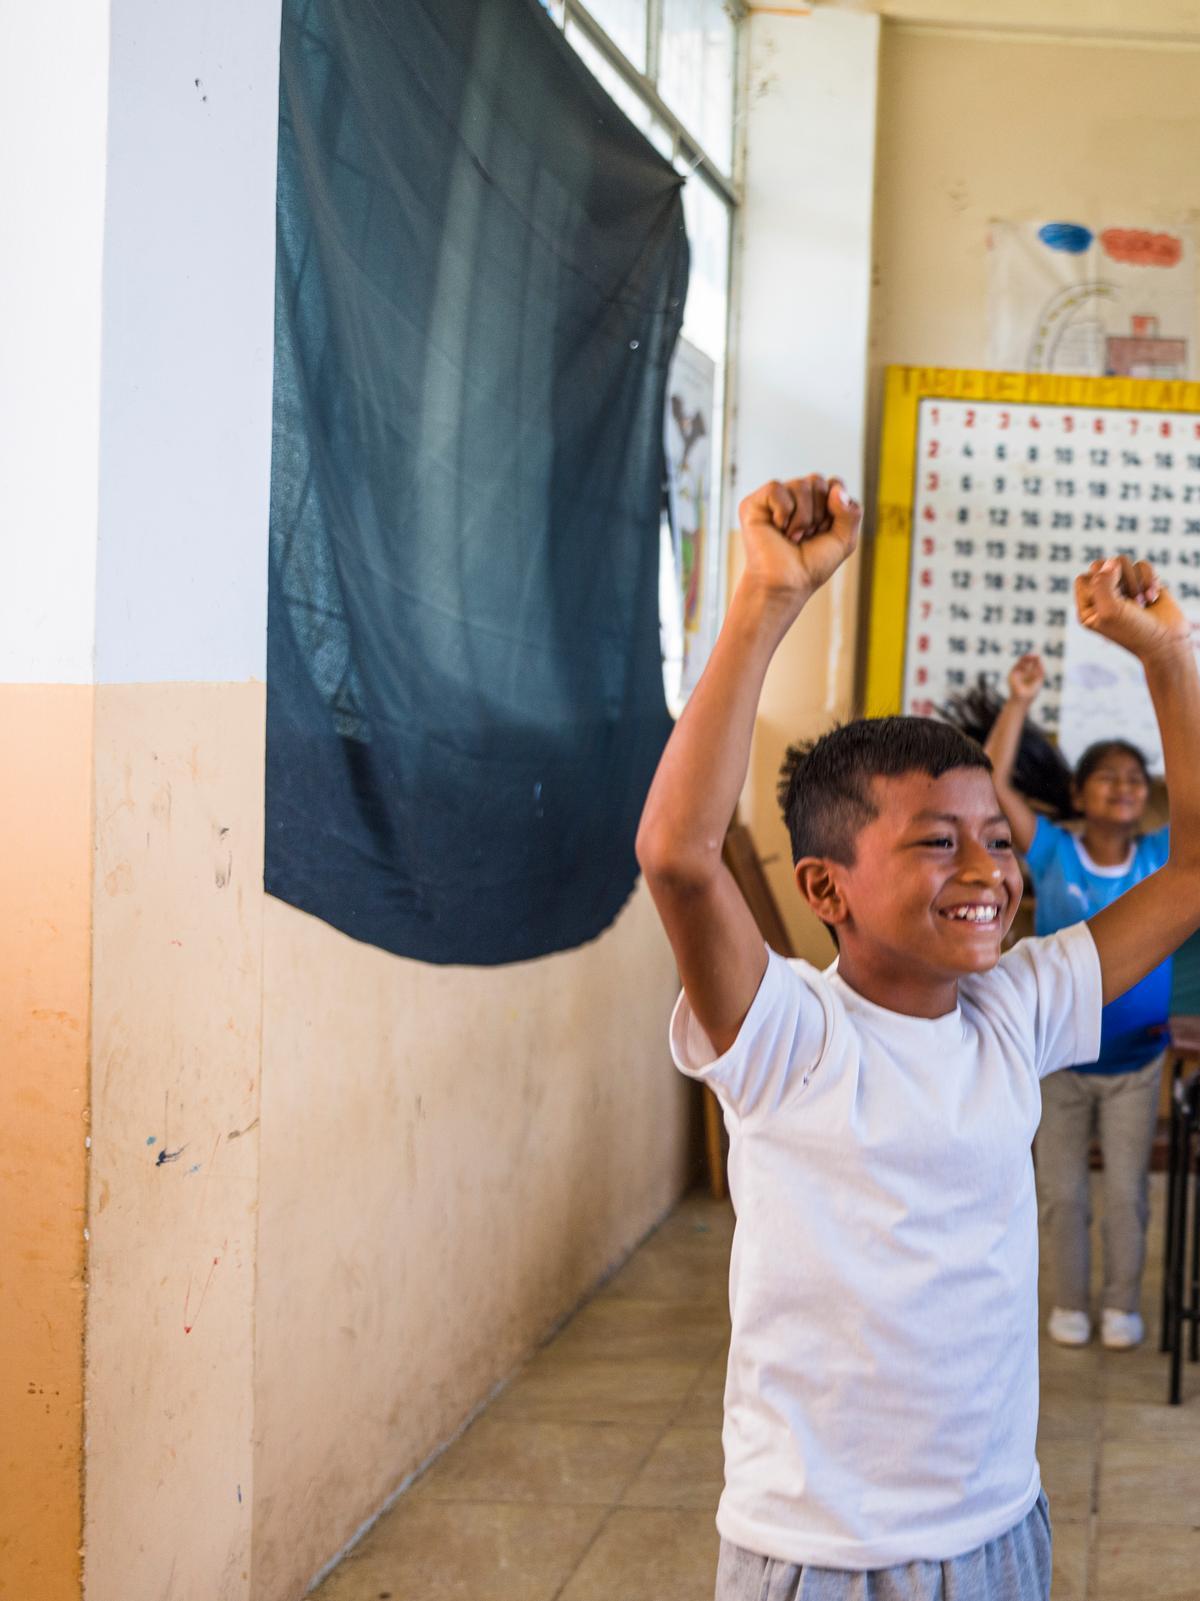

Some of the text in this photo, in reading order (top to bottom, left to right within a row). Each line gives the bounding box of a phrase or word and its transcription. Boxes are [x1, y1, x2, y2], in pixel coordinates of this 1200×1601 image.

[930, 406, 940, 426] 1
[964, 409, 977, 429] 2
[999, 411, 1011, 430] 3
[1028, 415, 1041, 431] 4
[1061, 414, 1075, 434] 5
[1092, 417, 1105, 435] 6
[1127, 417, 1140, 436] 7
[1159, 421, 1172, 439] 8
[927, 439, 940, 459] 2
[961, 444, 974, 459] 4
[995, 444, 1007, 462] 6
[1027, 445, 1039, 464] 8
[1053, 446, 1075, 466] 10
[1089, 448, 1110, 468] 12
[1120, 450, 1143, 468] 14
[1154, 452, 1175, 470] 16
[926, 471, 940, 492] 3
[960, 474, 973, 493] 6
[994, 476, 1006, 494] 9
[1021, 475, 1043, 497] 12
[1054, 479, 1076, 498] 15
[1088, 481, 1109, 499] 18
[1119, 481, 1142, 502] 21
[1149, 483, 1175, 503] 24
[922, 505, 937, 523] 4
[957, 507, 969, 525] 8
[987, 507, 1010, 528] 12
[1020, 509, 1041, 528] 16
[1050, 511, 1075, 530] 20
[1081, 512, 1108, 532] 24
[1115, 514, 1140, 534] 28
[1149, 516, 1173, 536] 32
[922, 536, 936, 556] 5
[953, 538, 976, 558] 10
[985, 540, 1007, 560] 15
[1015, 541, 1040, 561] 20
[1048, 543, 1074, 563] 25
[1145, 549, 1171, 568] 40
[920, 568, 933, 588] 6
[950, 570, 973, 591] 12
[984, 572, 1006, 591] 18
[1013, 573, 1039, 593] 24
[1047, 575, 1071, 594] 30
